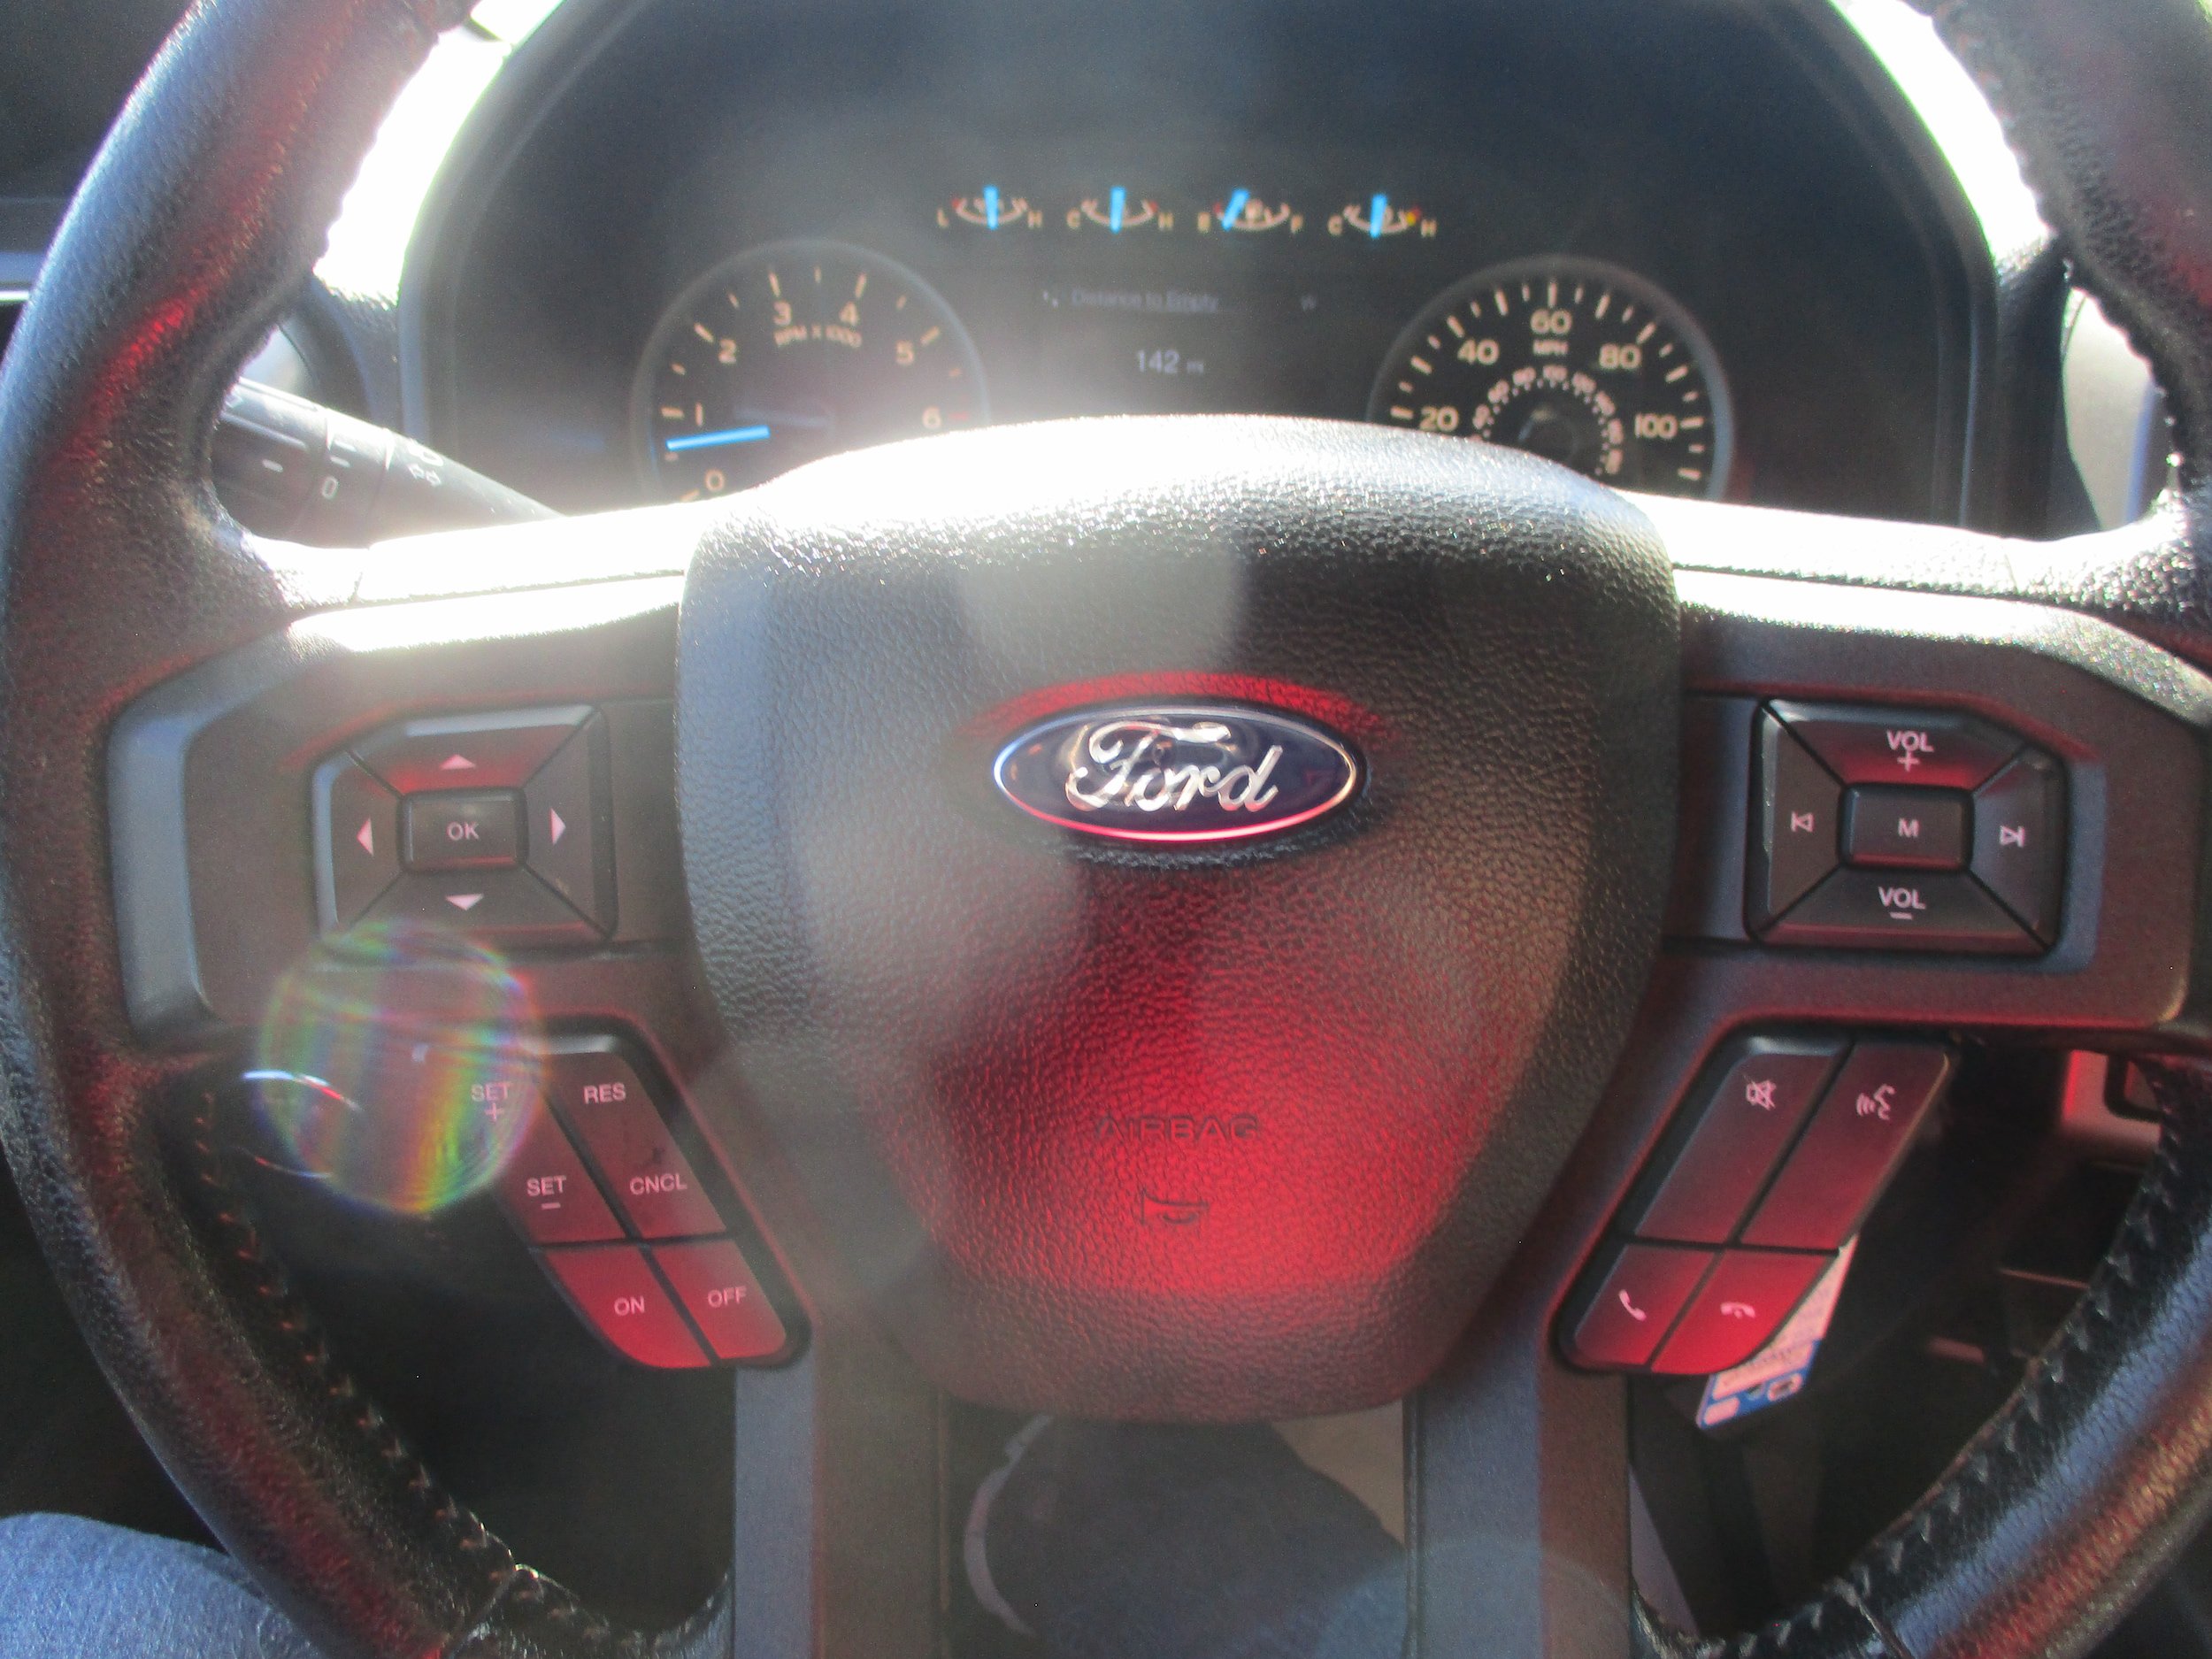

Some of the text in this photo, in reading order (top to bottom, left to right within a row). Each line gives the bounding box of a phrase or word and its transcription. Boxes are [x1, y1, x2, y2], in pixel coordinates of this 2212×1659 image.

[773, 300, 792, 326] 3
[839, 301, 859, 327] 4
[1530, 309, 1573, 335] 60
[718, 337, 738, 364] 2
[895, 340, 915, 366] 5
[1136, 349, 1180, 374] 142
[1457, 338, 1500, 365] 40
[1598, 343, 1642, 370] 80
[922, 405, 943, 430] 6
[1419, 405, 1460, 432] 20
[1634, 413, 1678, 440] 100
[1886, 730, 1935, 752] VOL
[1065, 719, 1284, 812] Ford
[445, 821, 480, 841] OK
[1897, 818, 1920, 838] M
[1877, 886, 1927, 910] VOL
[470, 1081, 511, 1102] SET
[582, 1083, 627, 1104] RES
[1095, 1114, 1259, 1145] AIRBAG
[526, 1175, 567, 1197] SET
[629, 1173, 688, 1196] CNCL
[613, 1295, 646, 1317] ON
[707, 1286, 748, 1309] OFF
